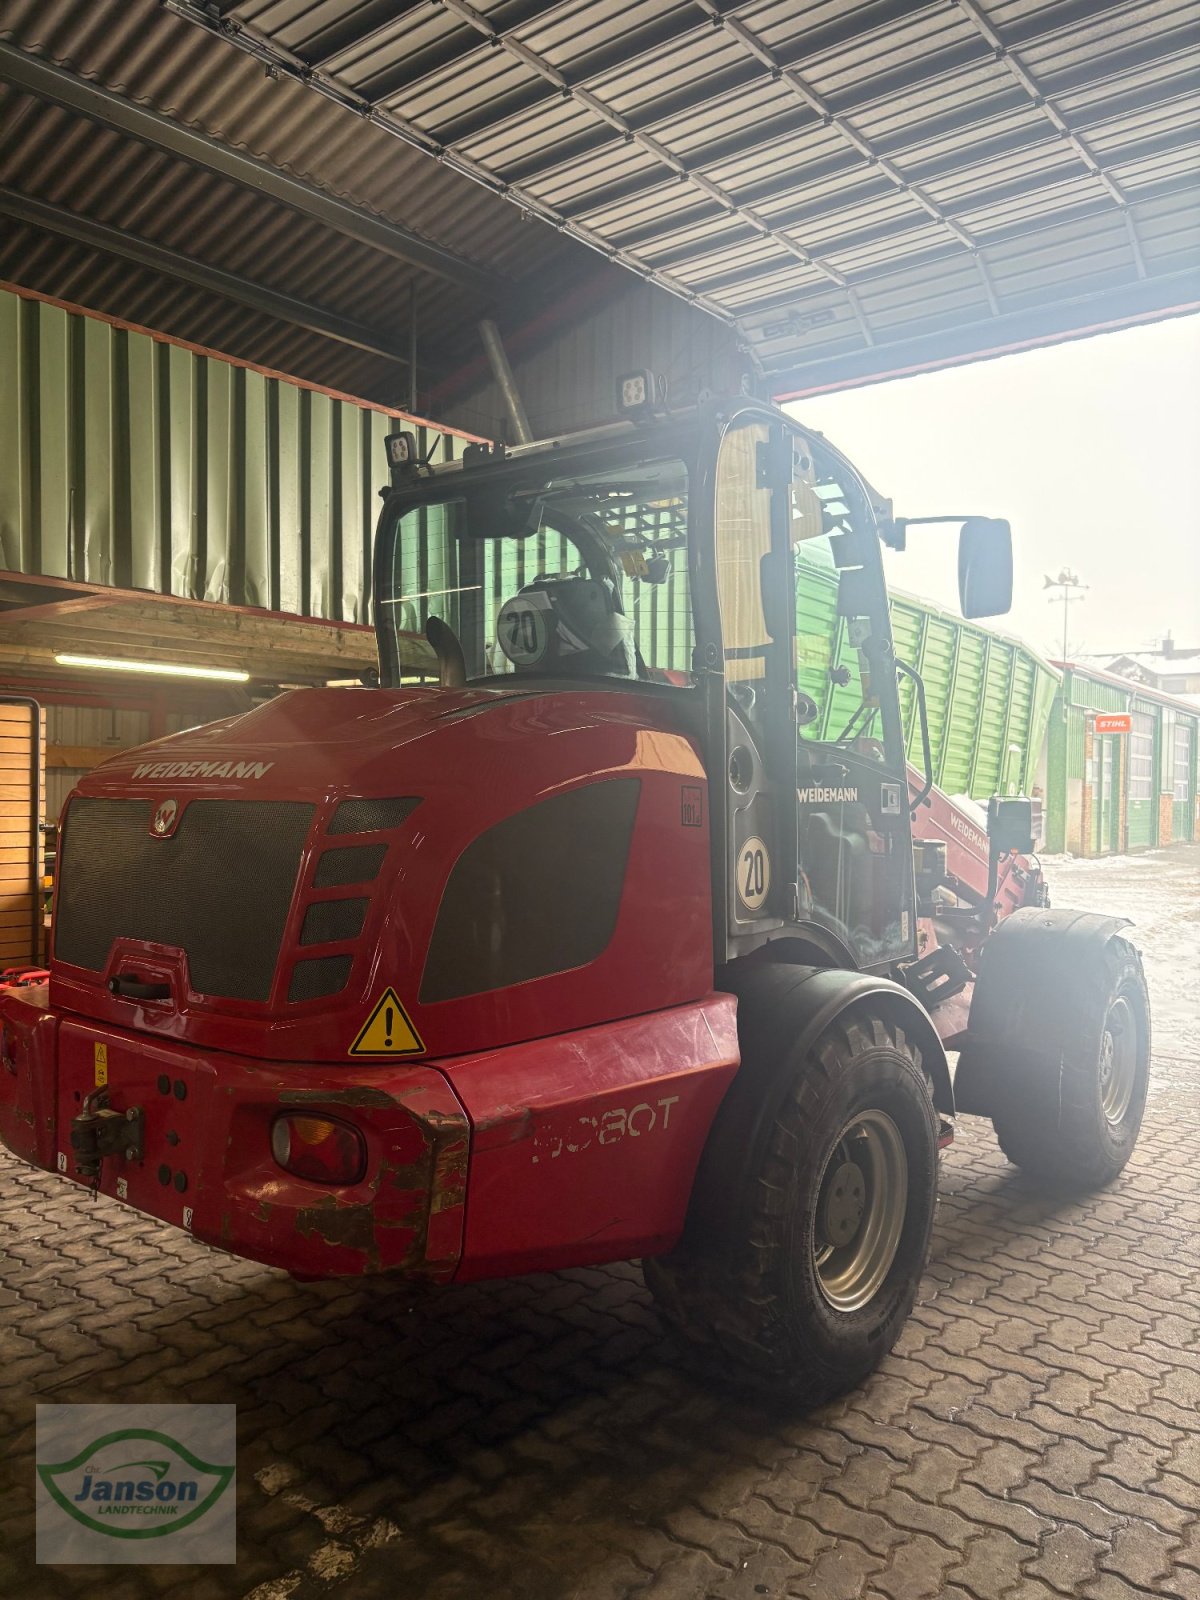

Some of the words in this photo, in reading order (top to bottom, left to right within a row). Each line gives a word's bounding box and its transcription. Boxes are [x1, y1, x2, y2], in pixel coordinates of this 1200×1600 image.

[506, 610, 537, 653] 20
[1099, 719, 1127, 729] STIHL
[131, 761, 275, 779] WEIDEMANN
[797, 787, 858, 802] WEIDEMANN
[950, 812, 988, 852] WEIDEMAN
[744, 849, 764, 897] 20
